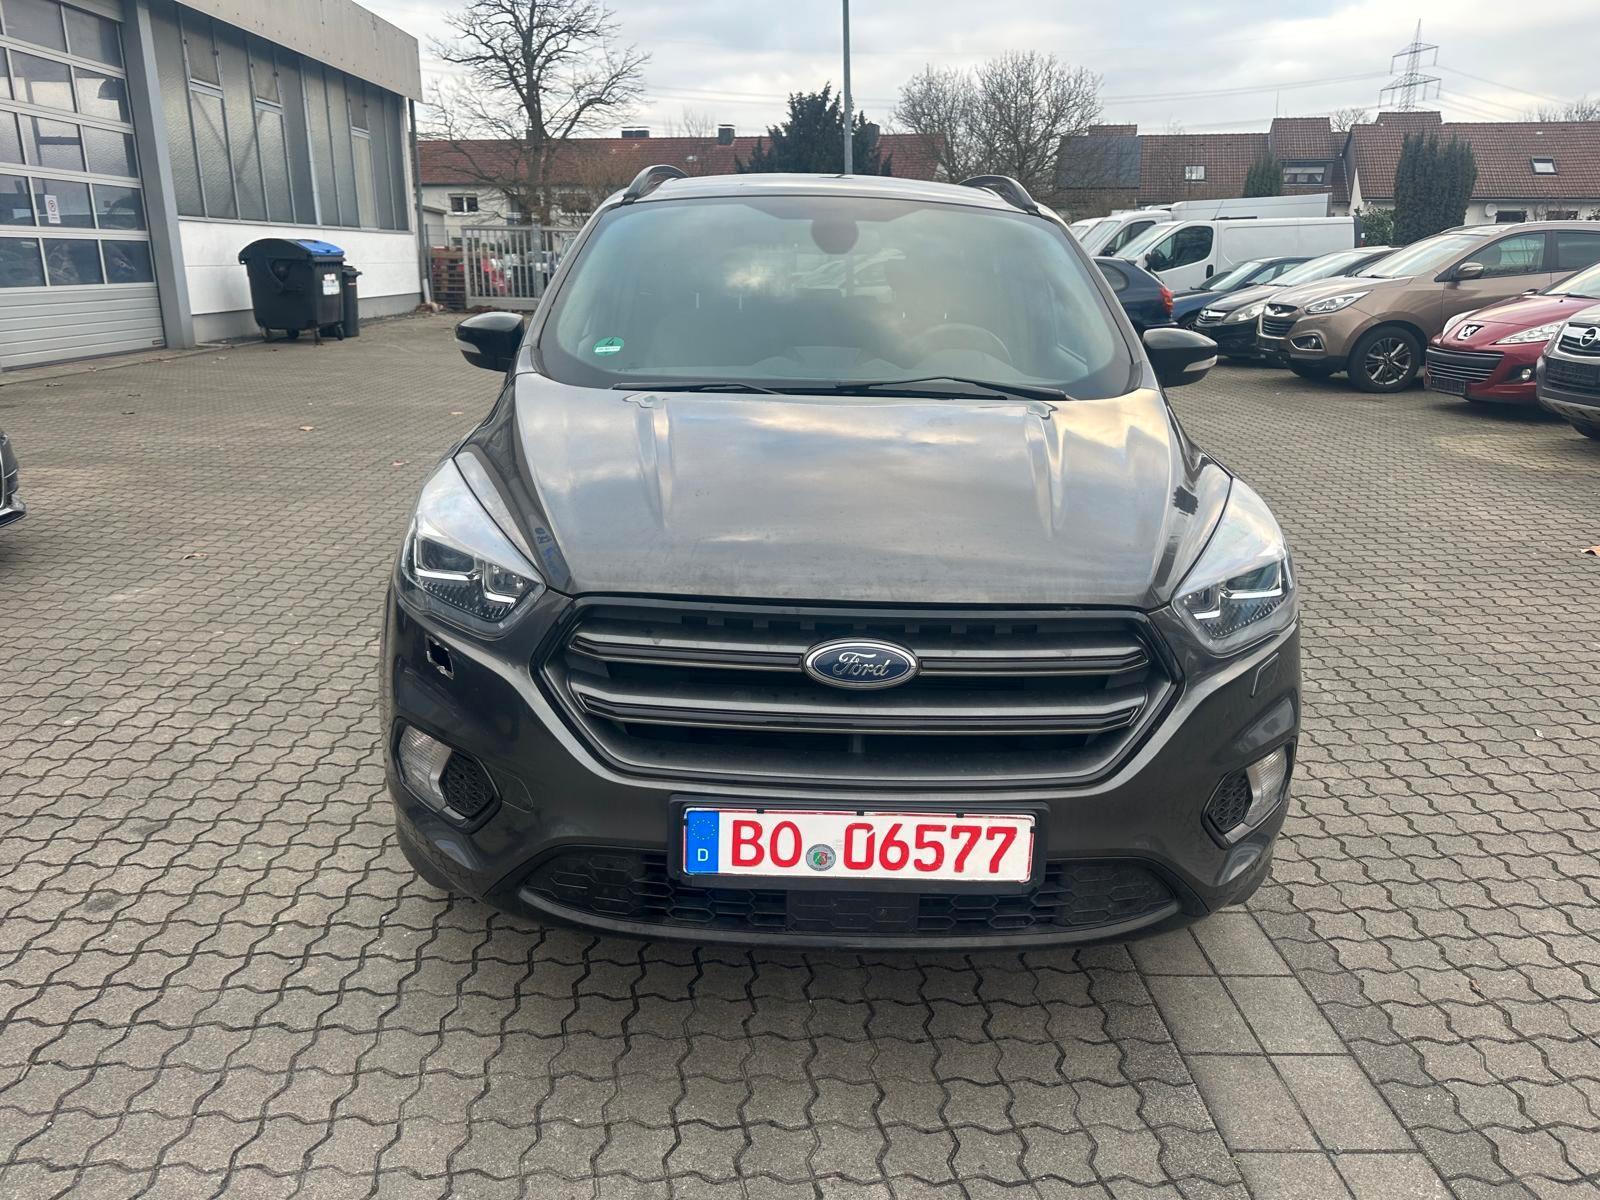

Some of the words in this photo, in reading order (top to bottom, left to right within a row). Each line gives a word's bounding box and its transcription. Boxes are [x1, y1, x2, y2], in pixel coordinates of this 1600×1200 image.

[832, 652, 891, 676] Ford
[697, 848, 709, 862] D
[731, 819, 803, 868] BO
[843, 822, 1018, 874] 06577
